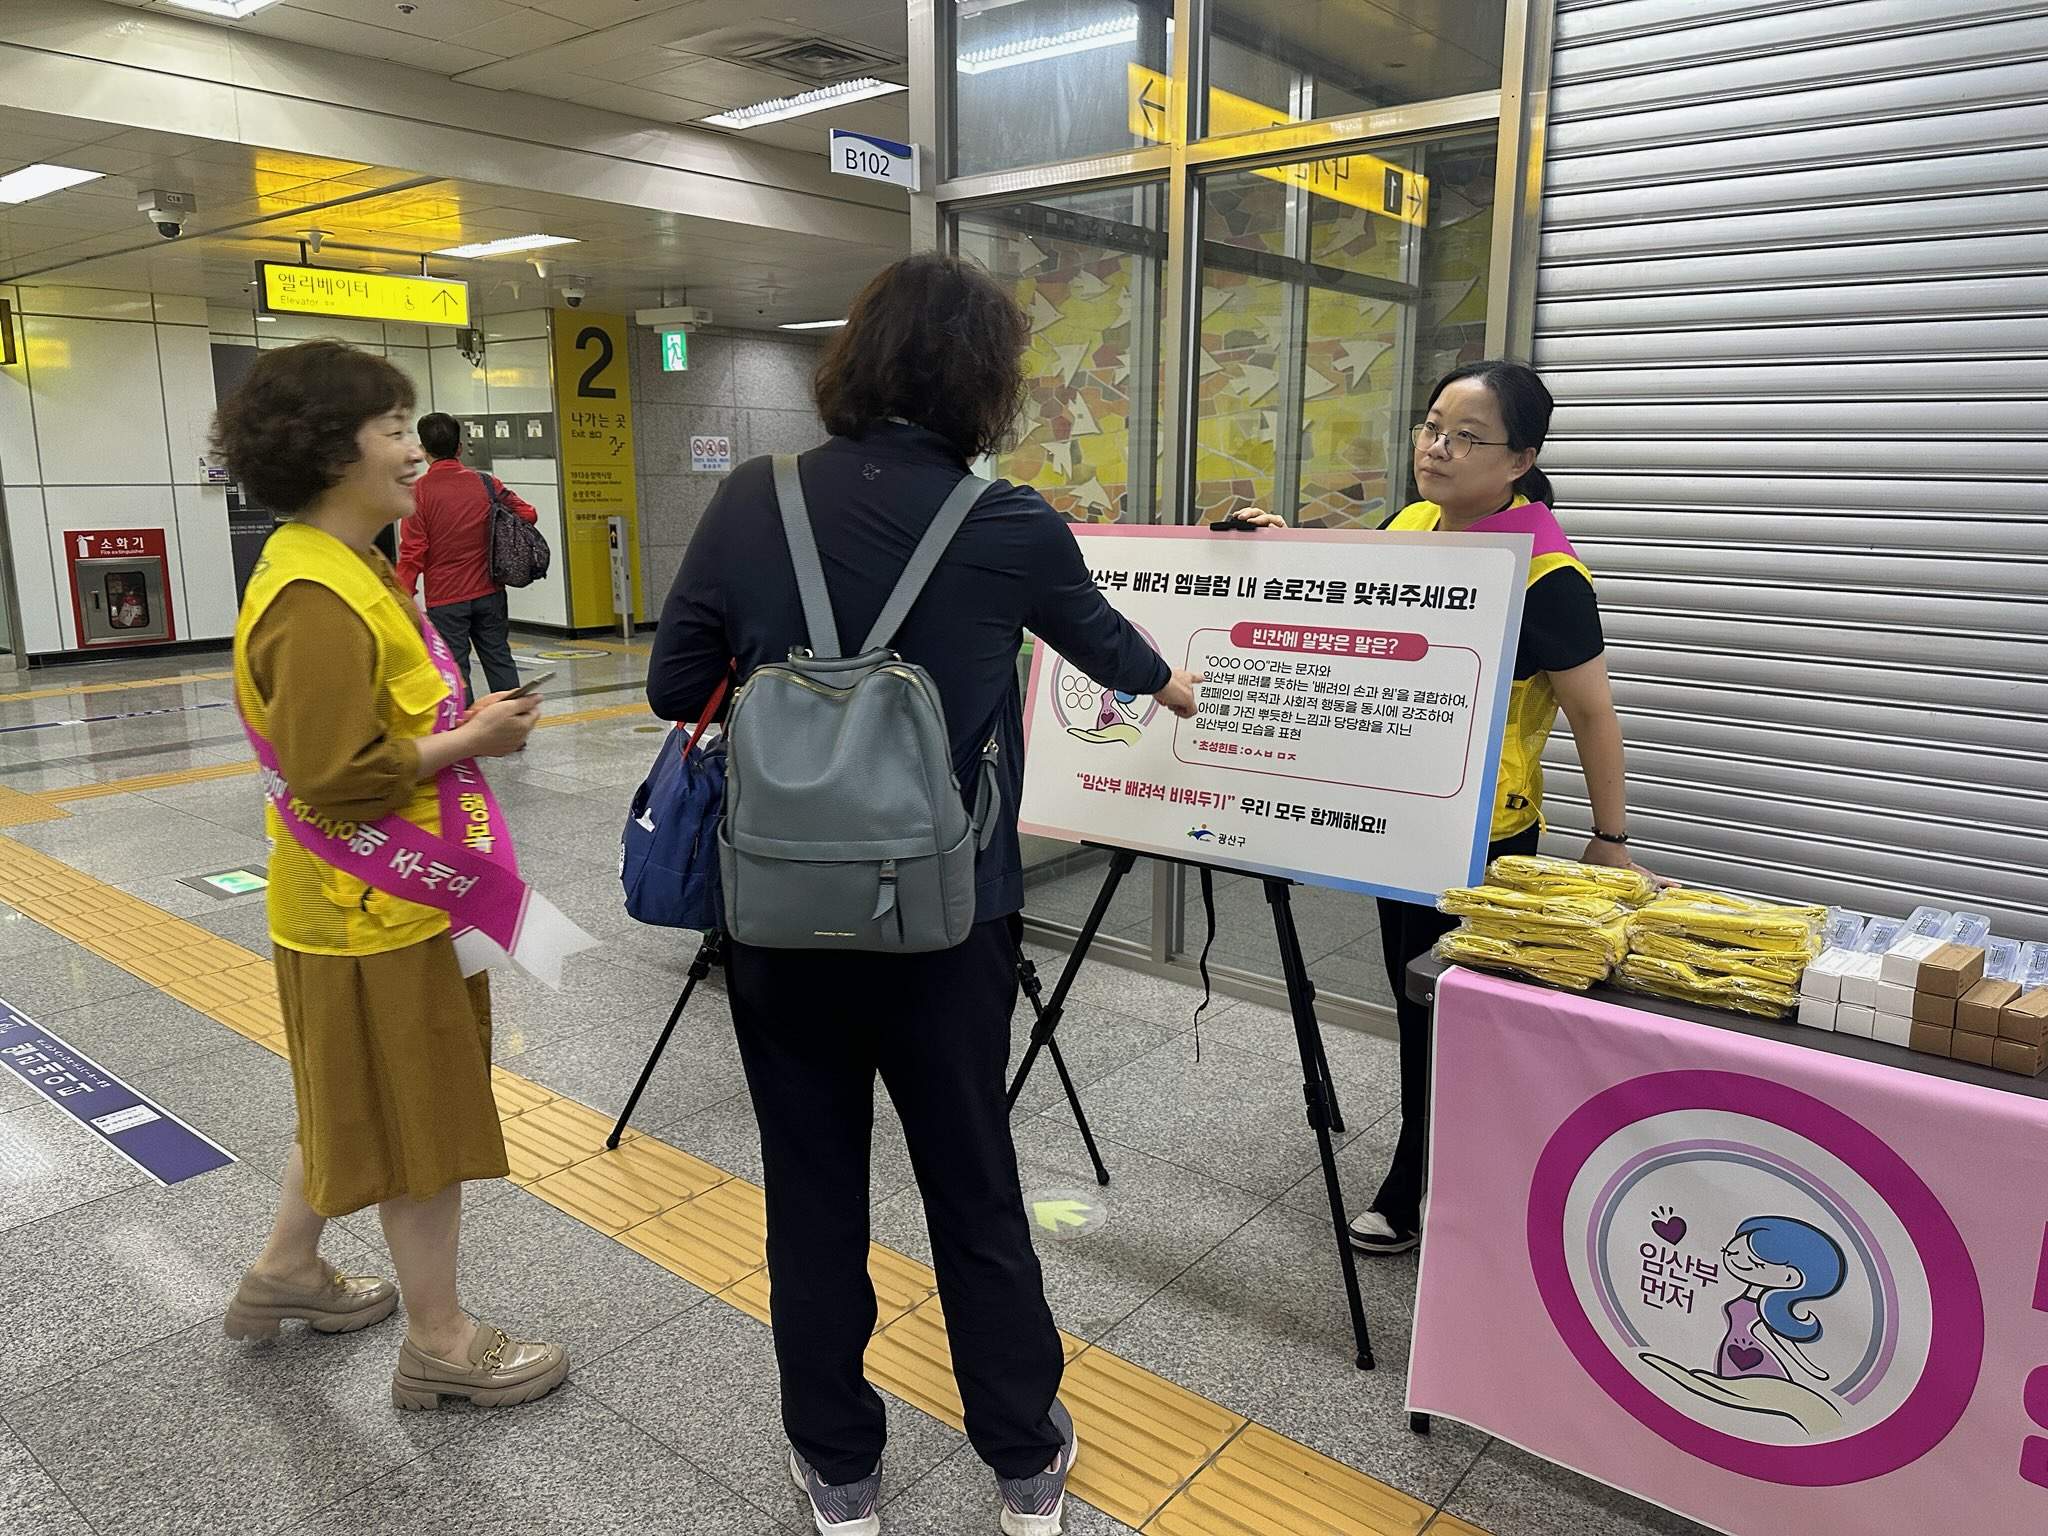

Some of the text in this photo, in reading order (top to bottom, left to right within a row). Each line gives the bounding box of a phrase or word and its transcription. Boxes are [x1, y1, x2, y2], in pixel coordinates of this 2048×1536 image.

[845, 147, 890, 177] B102
[278, 272, 369, 299] 엘리베이터
[280, 295, 319, 307] Elevator
[575, 326, 617, 400] 2
[571, 412, 626, 429] 나가는 곳
[571, 430, 586, 438] Exit
[101, 536, 144, 550] 소화기
[1132, 571, 1170, 594] 배려
[1174, 573, 1231, 597] 엠블럼
[1237, 576, 1257, 599] 내
[1263, 578, 1347, 604] 슬로건을
[1353, 582, 1478, 611] 맞춰주세요!
[1252, 628, 1399, 655] 빈칸에 알맞은 말은?
[1295, 662, 1331, 678] 문자와
[1237, 673, 1271, 688] 배려를
[1274, 677, 1308, 692] 뜻하는
[1353, 684, 1378, 699] 손과
[1413, 690, 1468, 709] 결합하여,
[1200, 686, 1454, 724] 캠페인의 목적과 사회적 행동을 동시에 강조하여
[1195, 717, 1302, 741] 임산부의 모습을 표현
[1198, 702, 1412, 737] 아이를 가진 뿌듯한 느낌과 당당함을 지닌
[1198, 740, 1238, 755] 초성힌트
[1124, 780, 1166, 801] 배려석
[1240, 797, 1271, 817] 우리
[1274, 802, 1306, 822] 모두
[1310, 807, 1387, 835] 함께해요!!
[1218, 833, 1246, 848] 광산구
[1640, 1242, 1719, 1288] 임산부
[1640, 1274, 1694, 1314] 먼저
